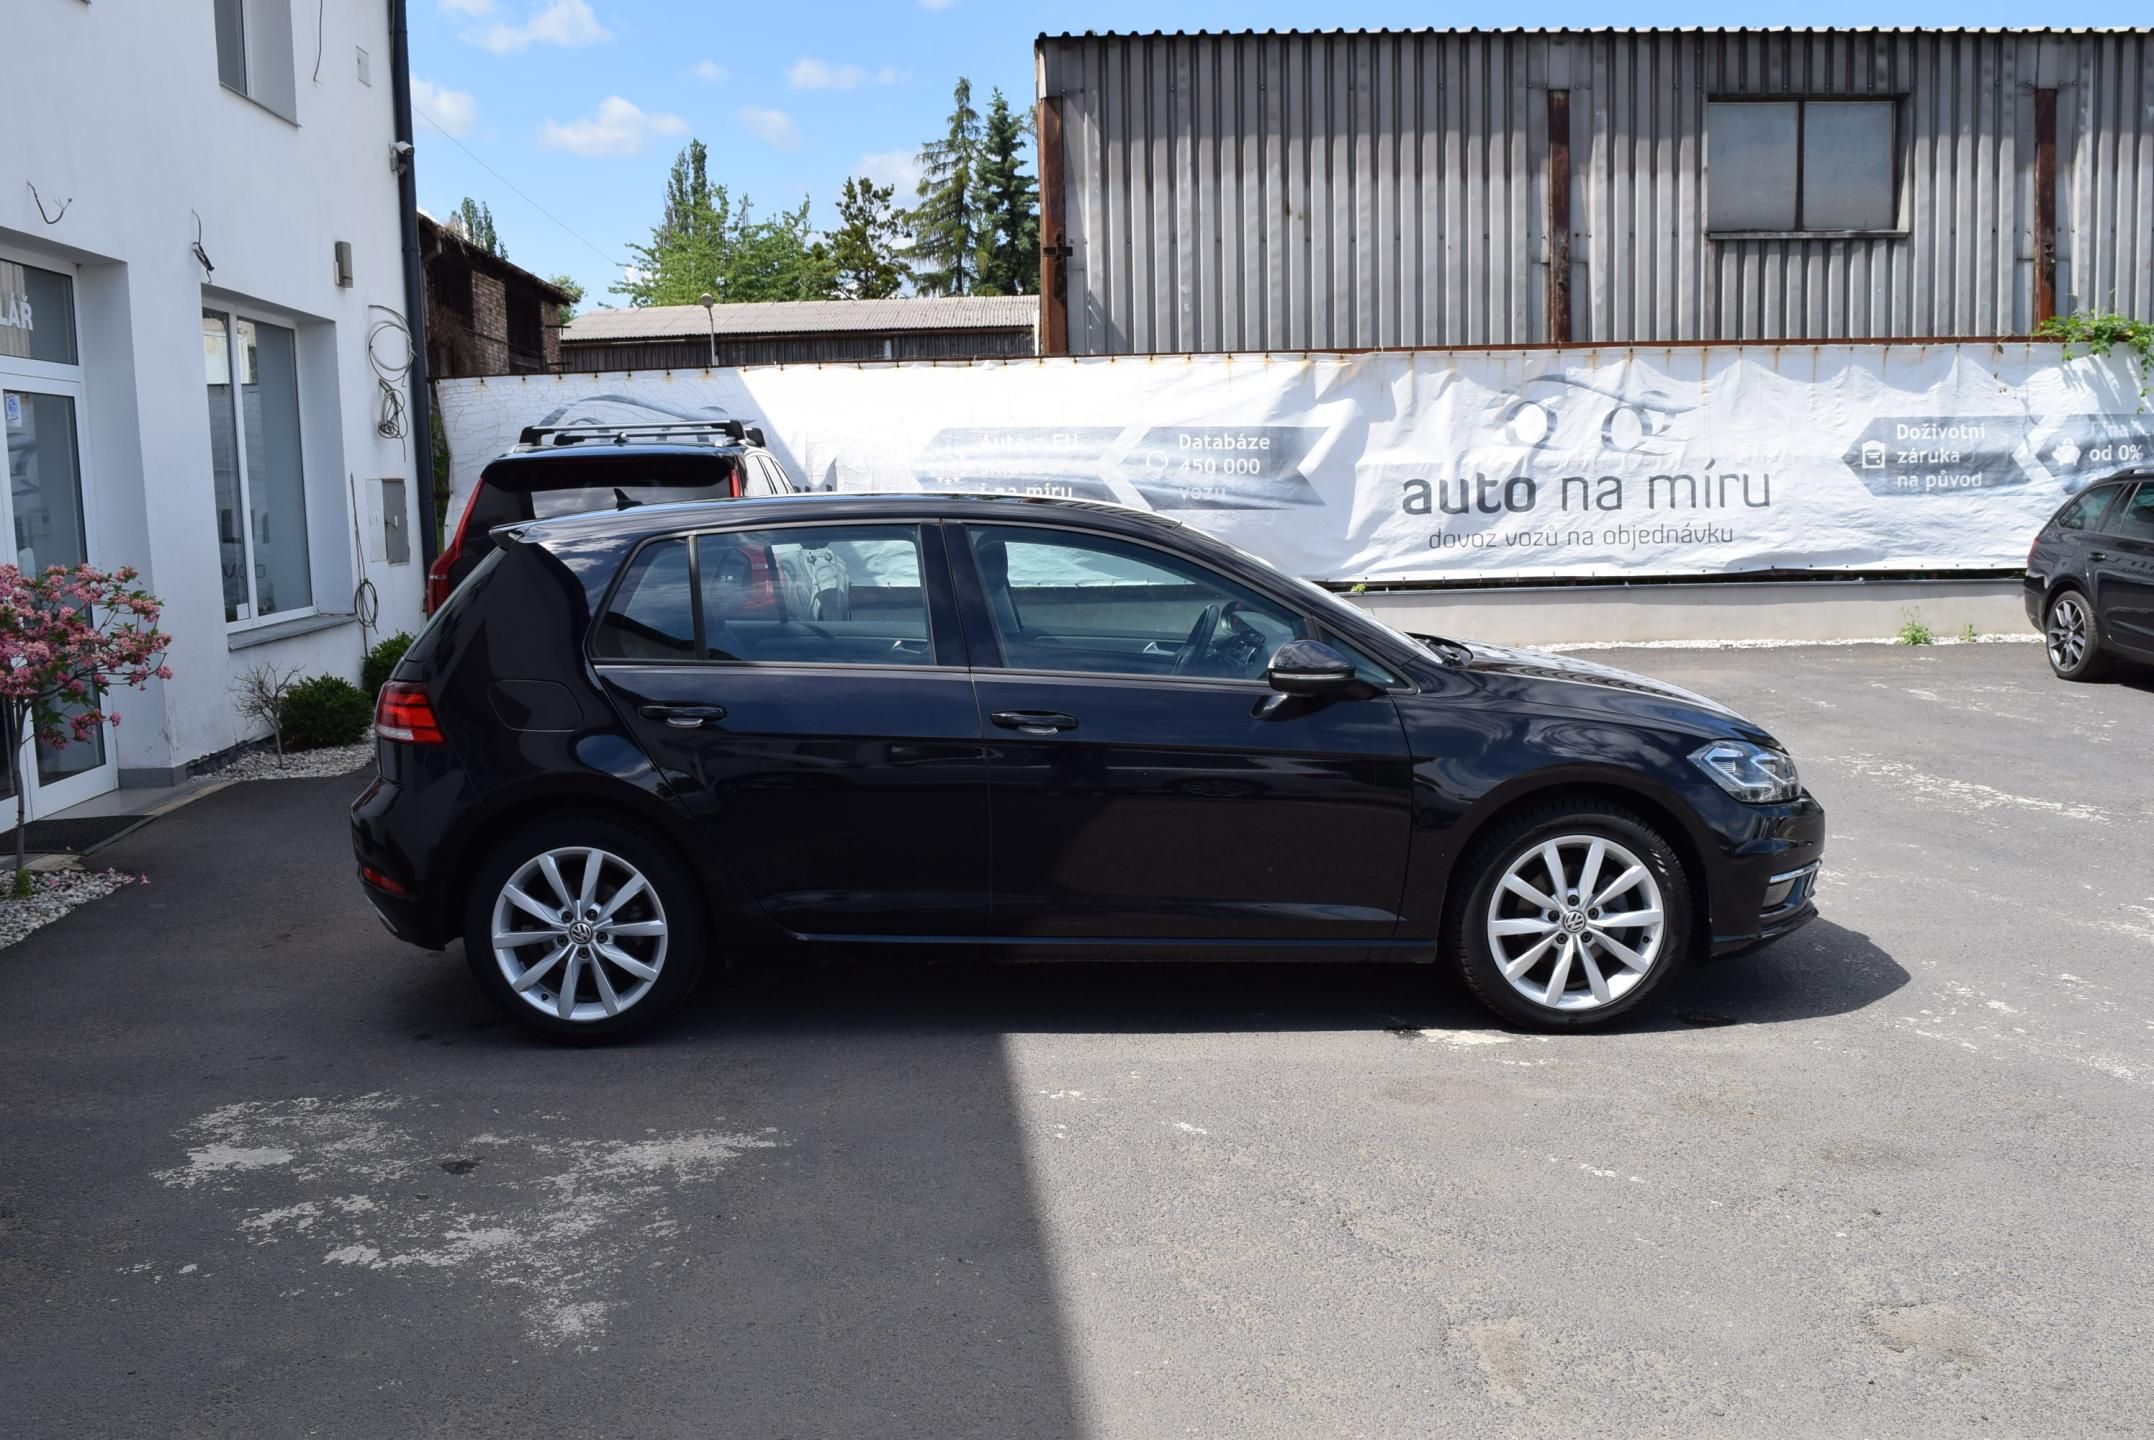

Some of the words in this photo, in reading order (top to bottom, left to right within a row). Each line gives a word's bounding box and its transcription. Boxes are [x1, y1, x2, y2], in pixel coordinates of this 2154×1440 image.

[1896, 422, 1985, 440] Doživotní
[1179, 433, 1270, 450] Databáze
[1897, 447, 1960, 464] záruka
[2089, 444, 2112, 461] od
[2118, 444, 2144, 461] 0%
[1180, 458, 1216, 474] 450
[1223, 458, 1260, 474] 000
[1402, 472, 1537, 515] auto
[1561, 475, 1622, 512] na
[1648, 458, 1770, 510] míru
[1897, 475, 1919, 488] na
[1925, 469, 1983, 492] původ
[1429, 528, 1497, 549] dovoz
[1506, 525, 1558, 547] vozů
[1567, 530, 1594, 546] na
[1603, 522, 1733, 550] objednávku
